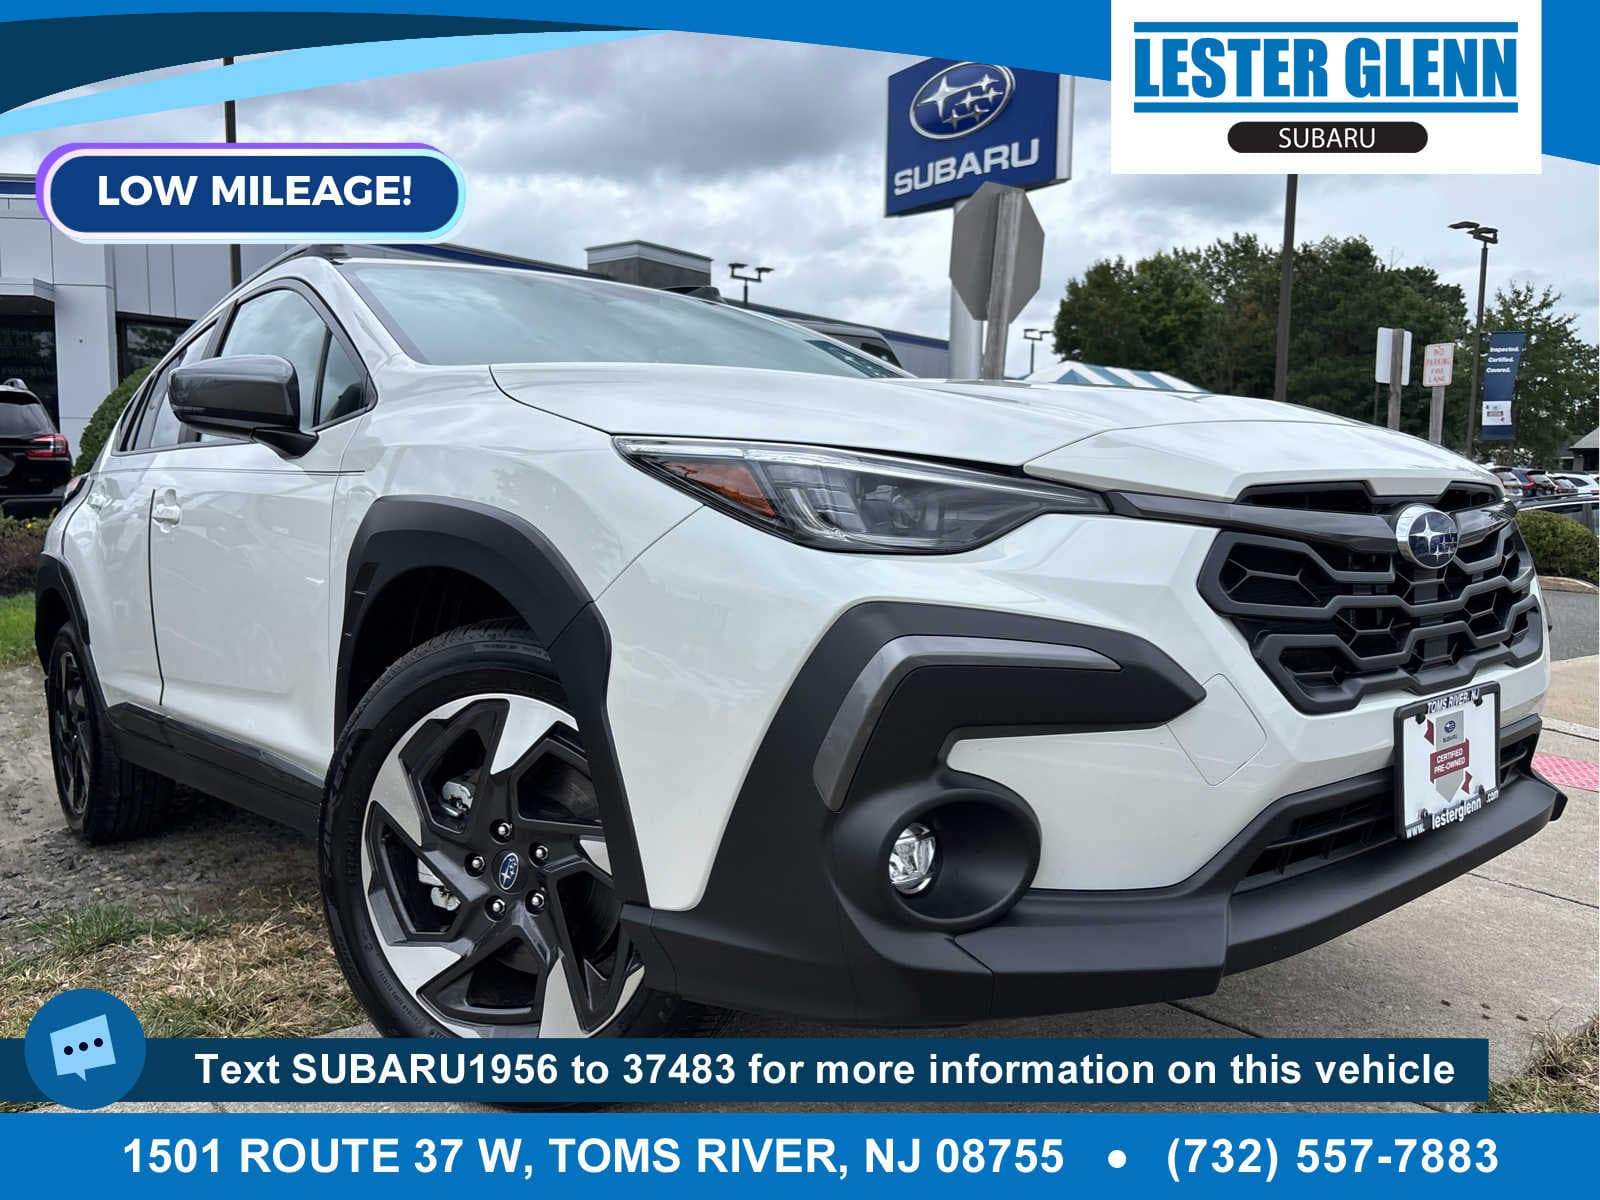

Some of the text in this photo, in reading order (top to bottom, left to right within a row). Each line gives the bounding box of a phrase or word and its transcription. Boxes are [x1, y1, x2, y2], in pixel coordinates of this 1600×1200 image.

[893, 138, 1040, 196] SUBARU
[1427, 698, 1447, 714] TOMS
[1437, 748, 1463, 763] CERTIFIED
[1433, 757, 1465, 774] PRE-OWNED
[1432, 798, 1481, 830] lesterglenn
